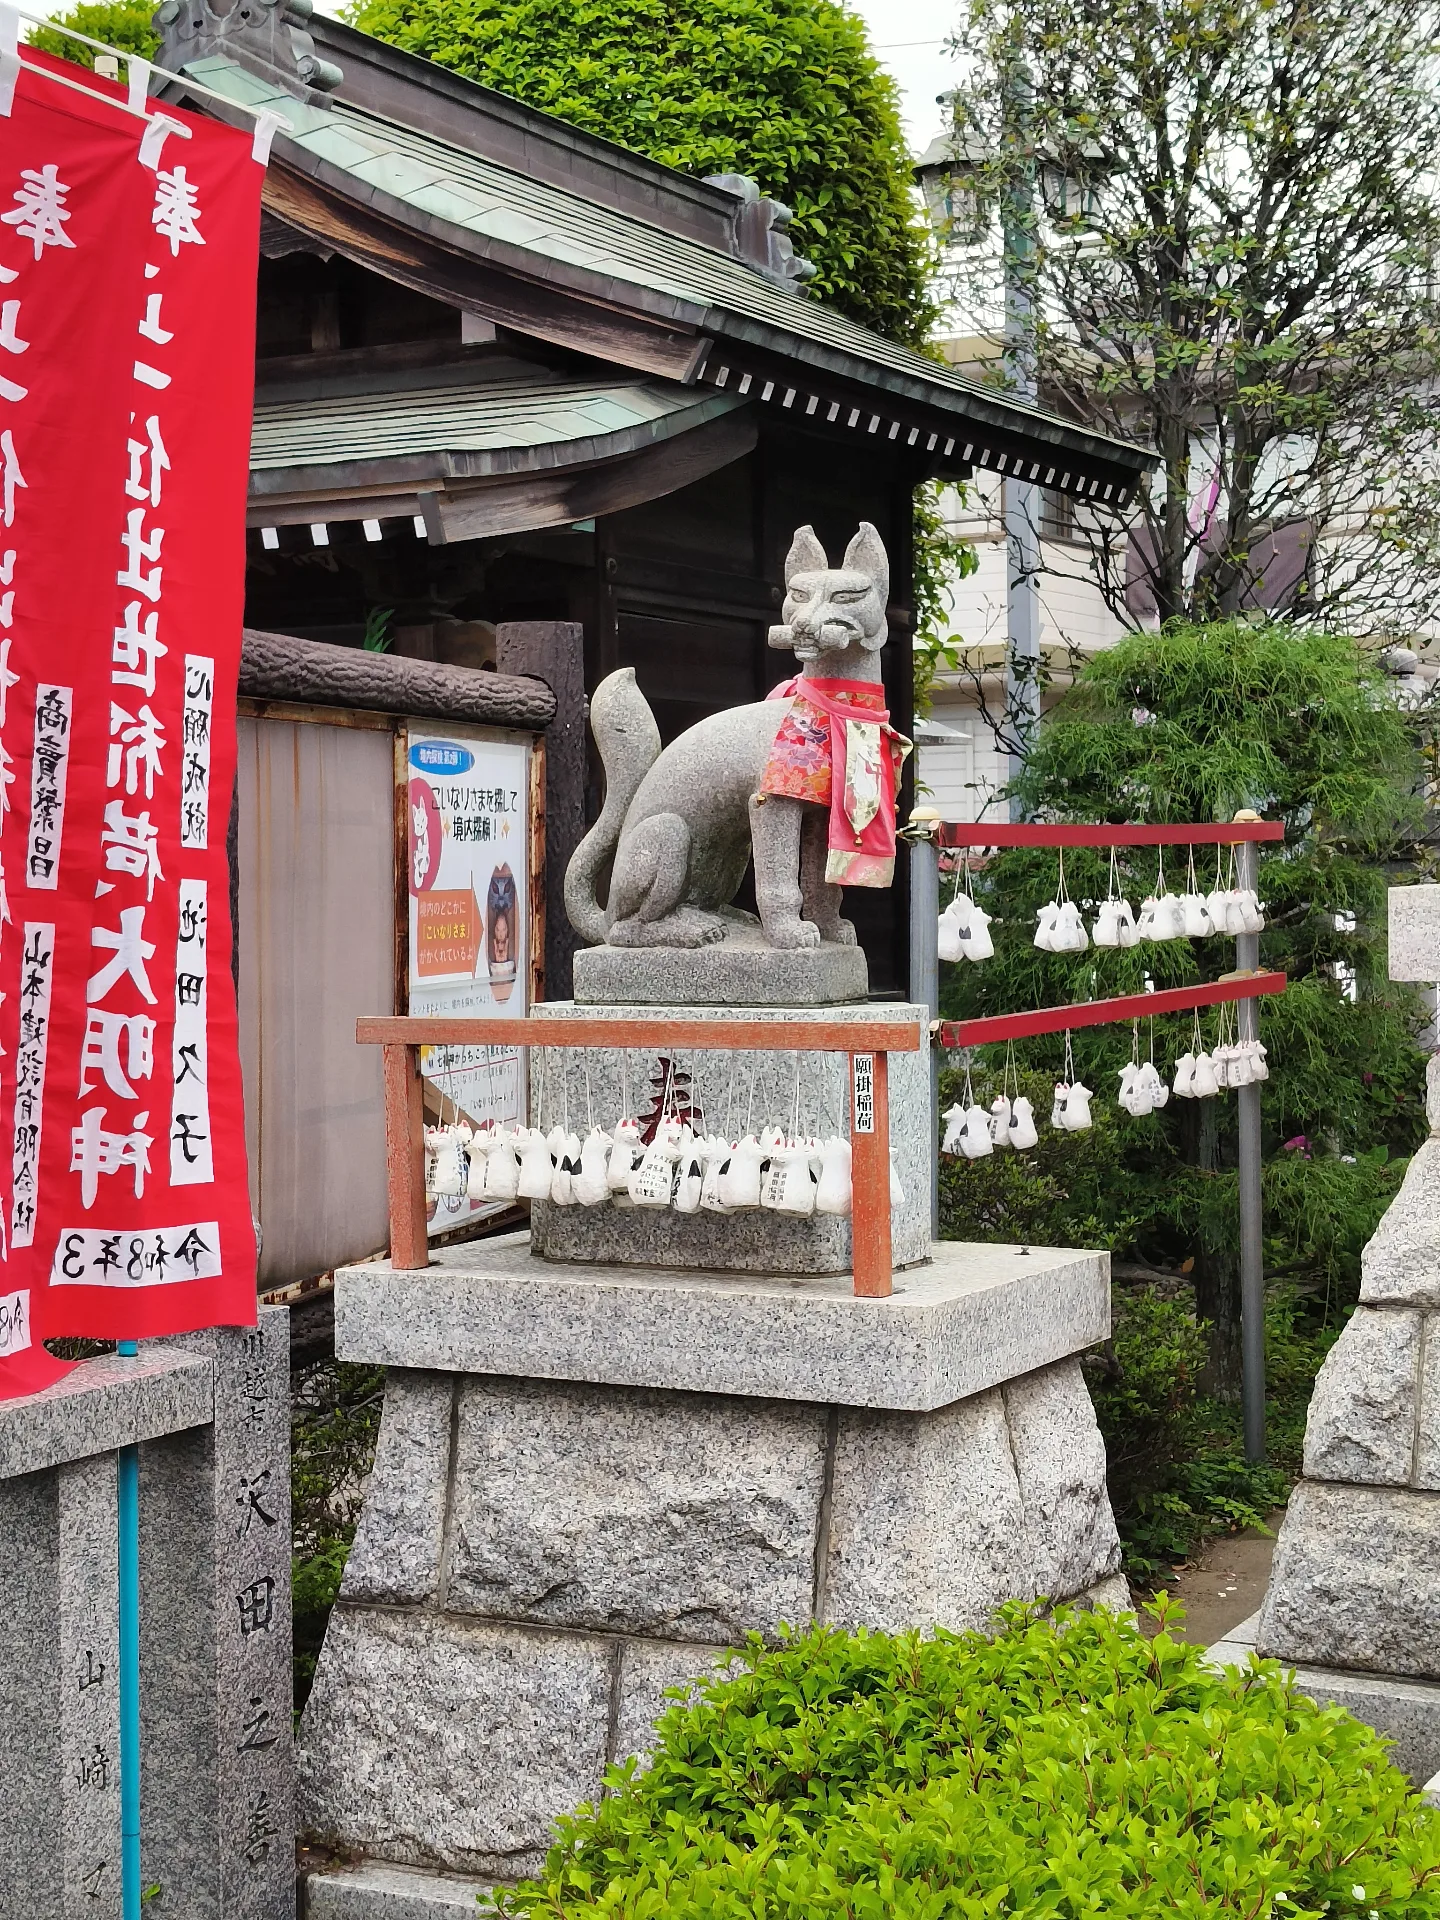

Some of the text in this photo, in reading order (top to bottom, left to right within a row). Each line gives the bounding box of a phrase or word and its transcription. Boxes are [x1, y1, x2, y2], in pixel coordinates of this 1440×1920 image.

[431, 787, 518, 813] こいなりさまを探して
[420, 901, 466, 917] 境内のどこかに
[855, 1057, 872, 1129] 願掛稲荷
